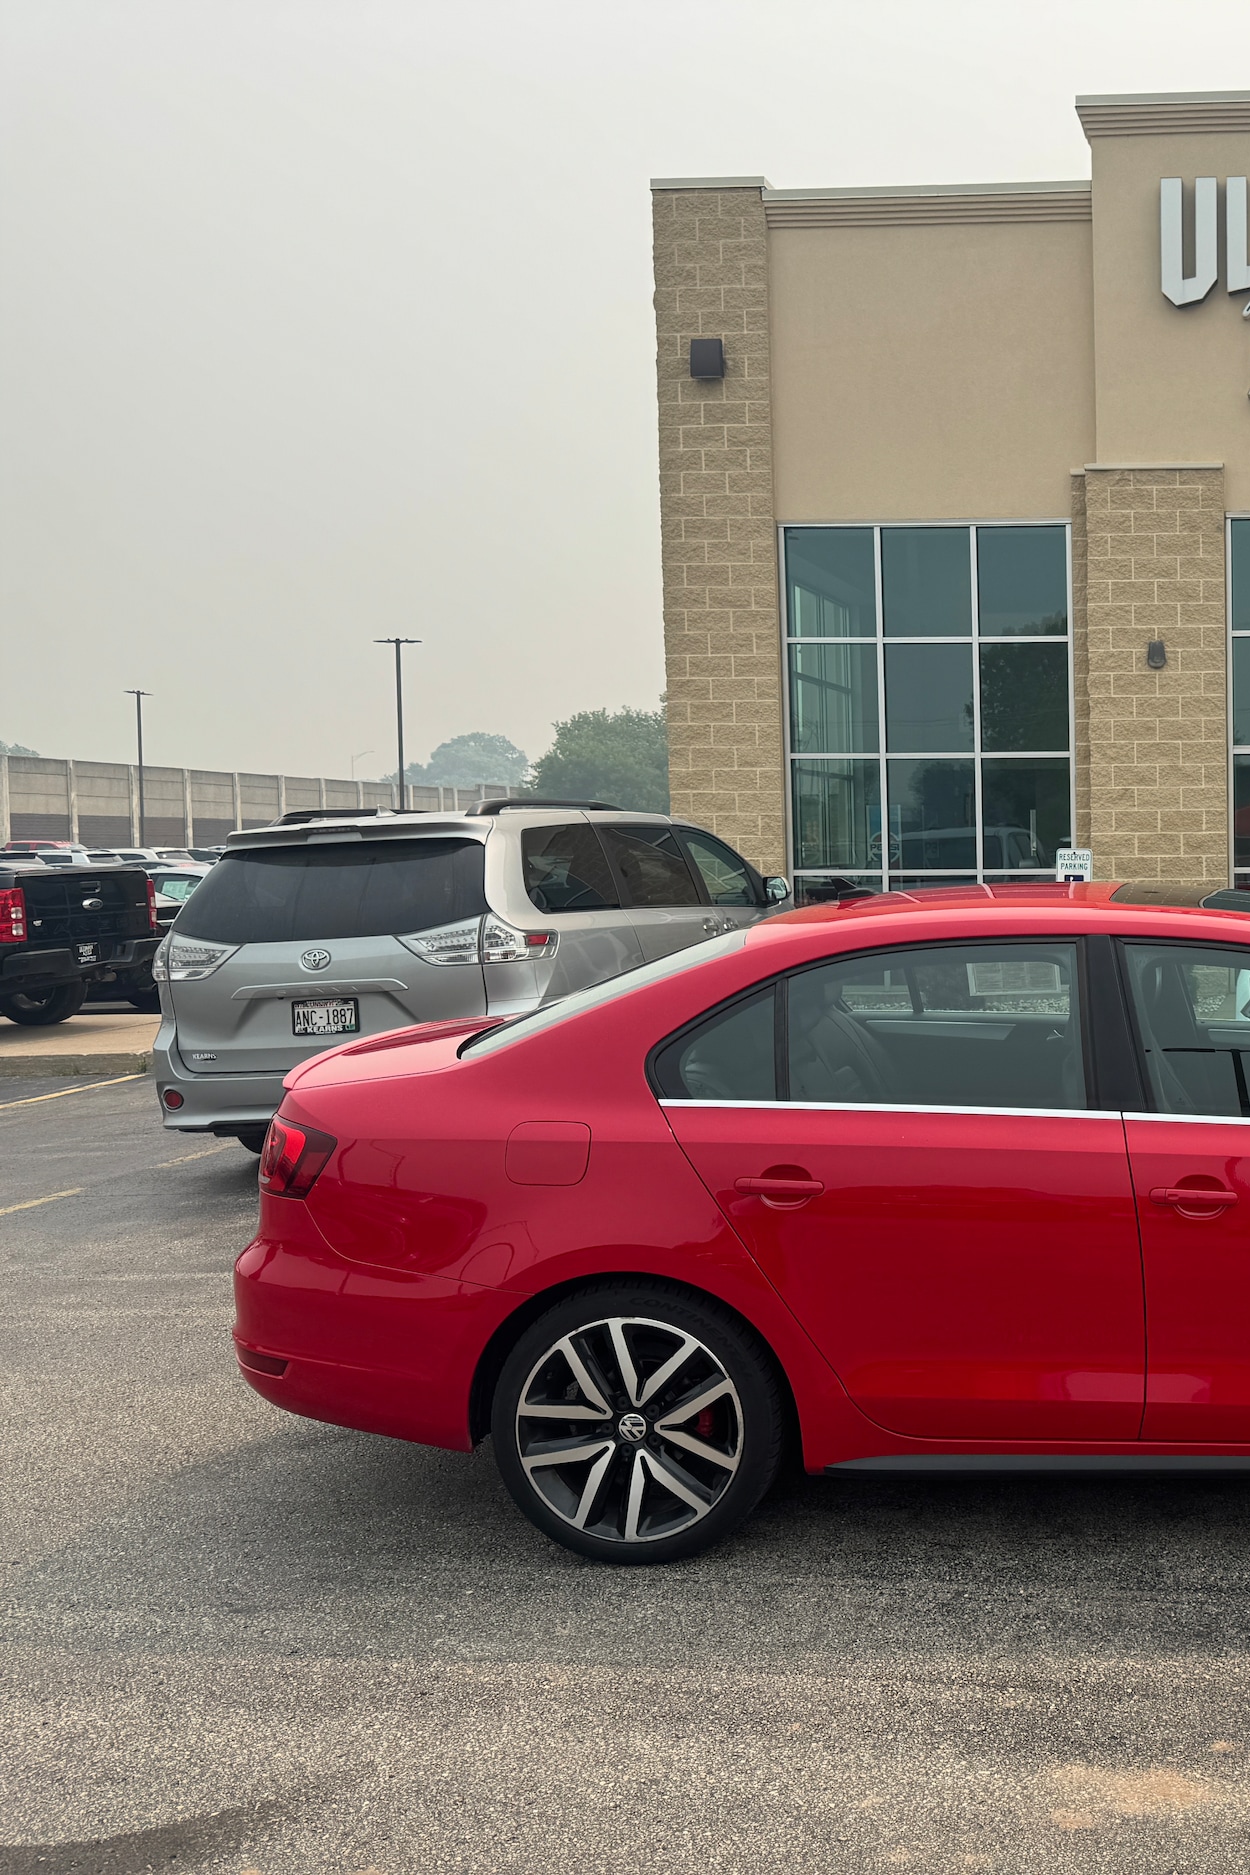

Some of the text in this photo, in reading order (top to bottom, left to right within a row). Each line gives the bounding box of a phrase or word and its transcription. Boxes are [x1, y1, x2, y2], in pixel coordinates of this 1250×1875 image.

[870, 843, 900, 851] PESI
[1059, 853, 1090, 861] RESERVED
[1060, 862, 1088, 871] PARKING
[296, 1008, 353, 1028] ANC-1887
